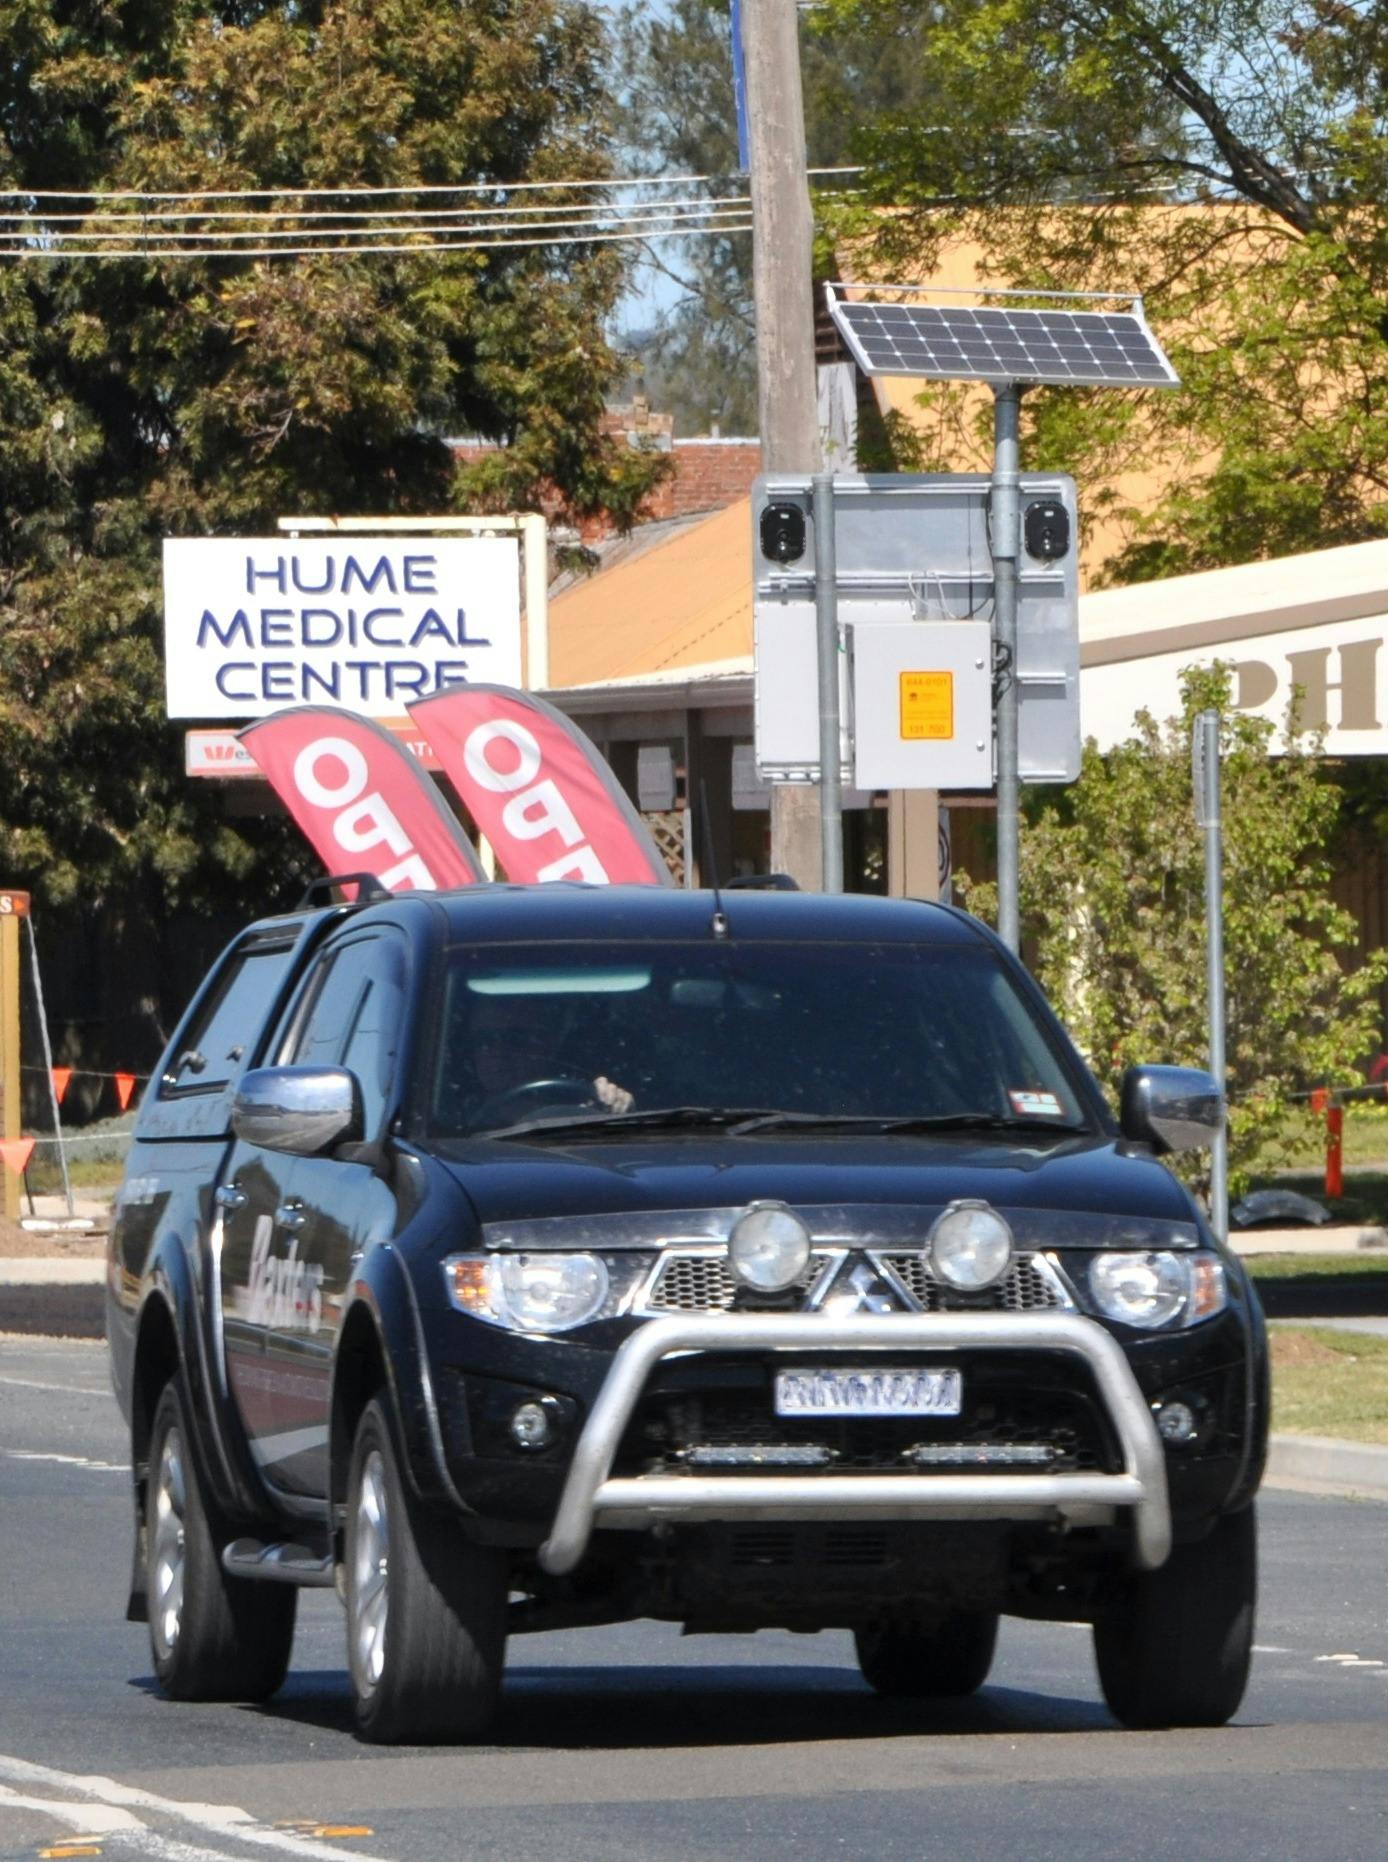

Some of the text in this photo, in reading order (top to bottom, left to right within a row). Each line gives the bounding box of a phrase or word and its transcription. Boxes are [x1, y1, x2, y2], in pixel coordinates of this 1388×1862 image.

[245, 554, 439, 595] HUME
[196, 607, 492, 649] MEDICAL
[214, 661, 471, 700] CENTRE
